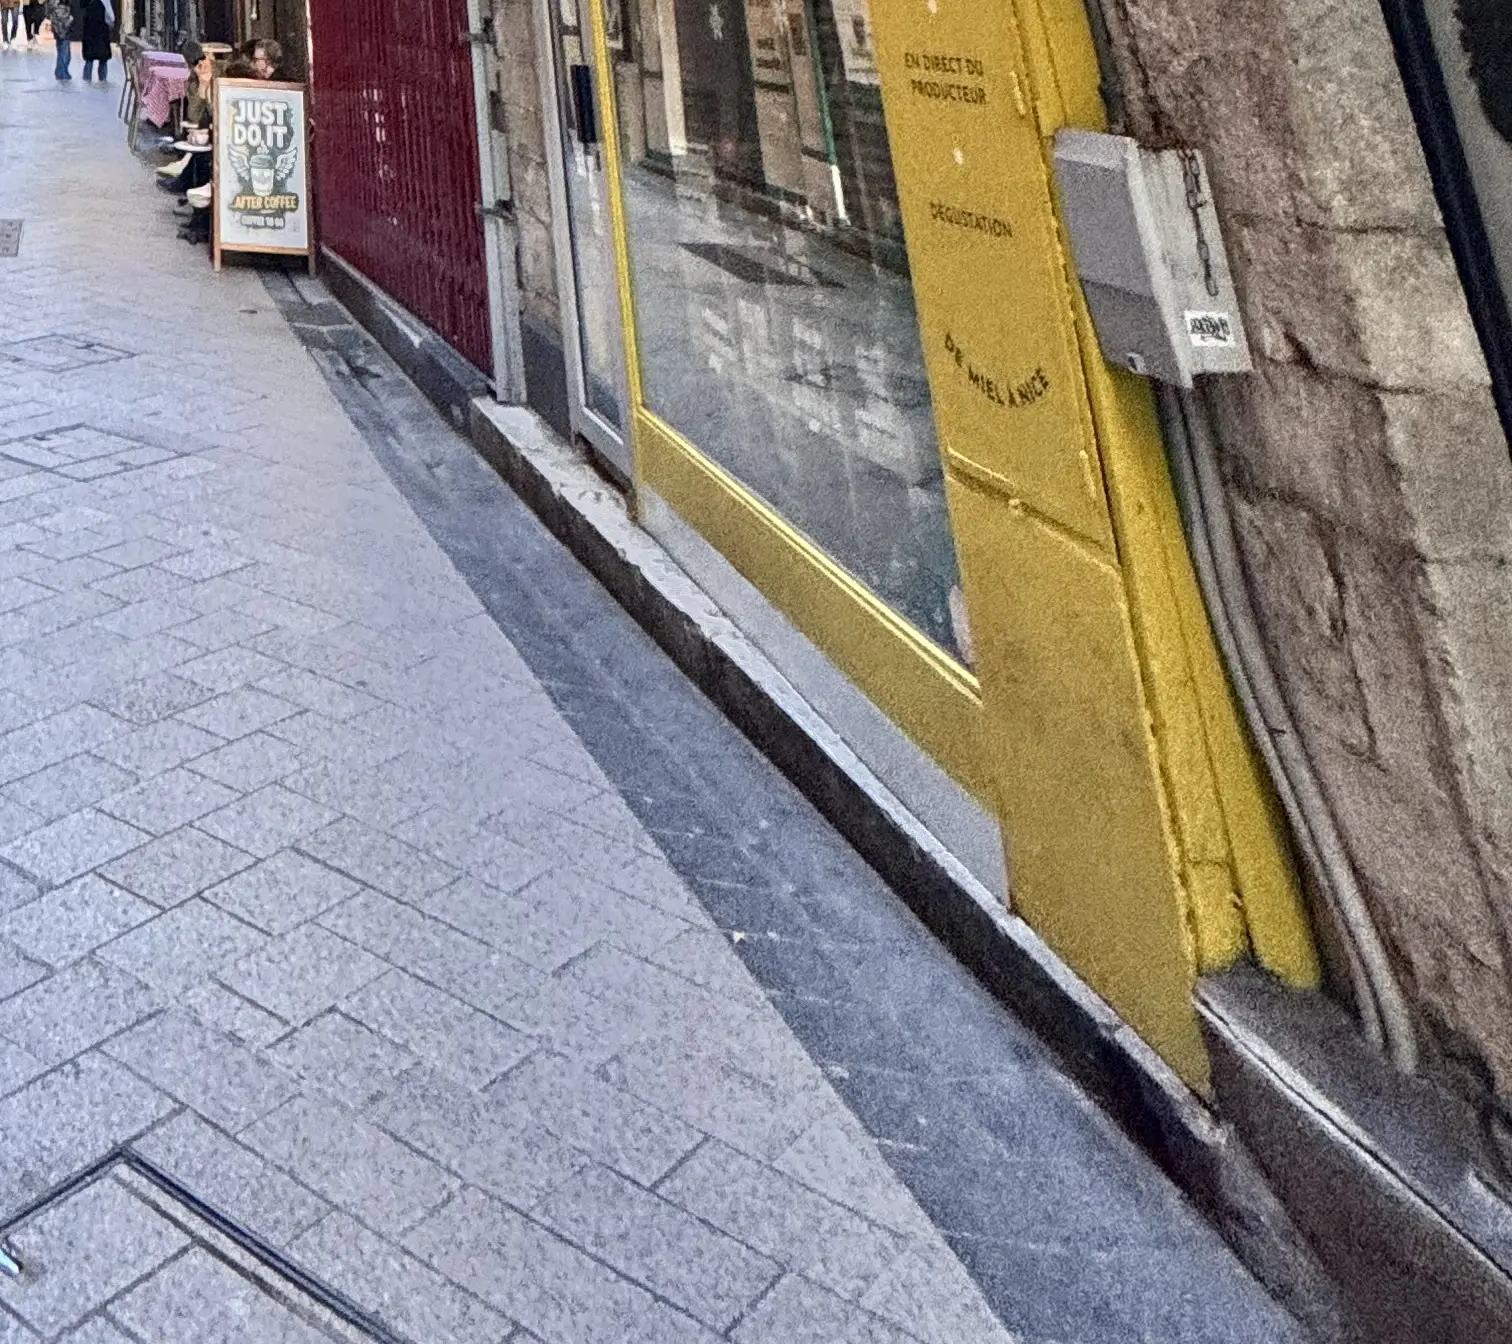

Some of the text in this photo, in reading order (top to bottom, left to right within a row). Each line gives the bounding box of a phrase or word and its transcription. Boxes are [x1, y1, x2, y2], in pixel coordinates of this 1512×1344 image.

[904, 52, 984, 77] EN DIRECT DU
[911, 78, 987, 105] PRODUCTEUR
[233, 99, 288, 126] JUST
[233, 123, 288, 149] DO IT
[235, 194, 297, 211] AFTER COFFEE
[968, 365, 1005, 407] MIEL
[1016, 366, 1049, 407] NICE
